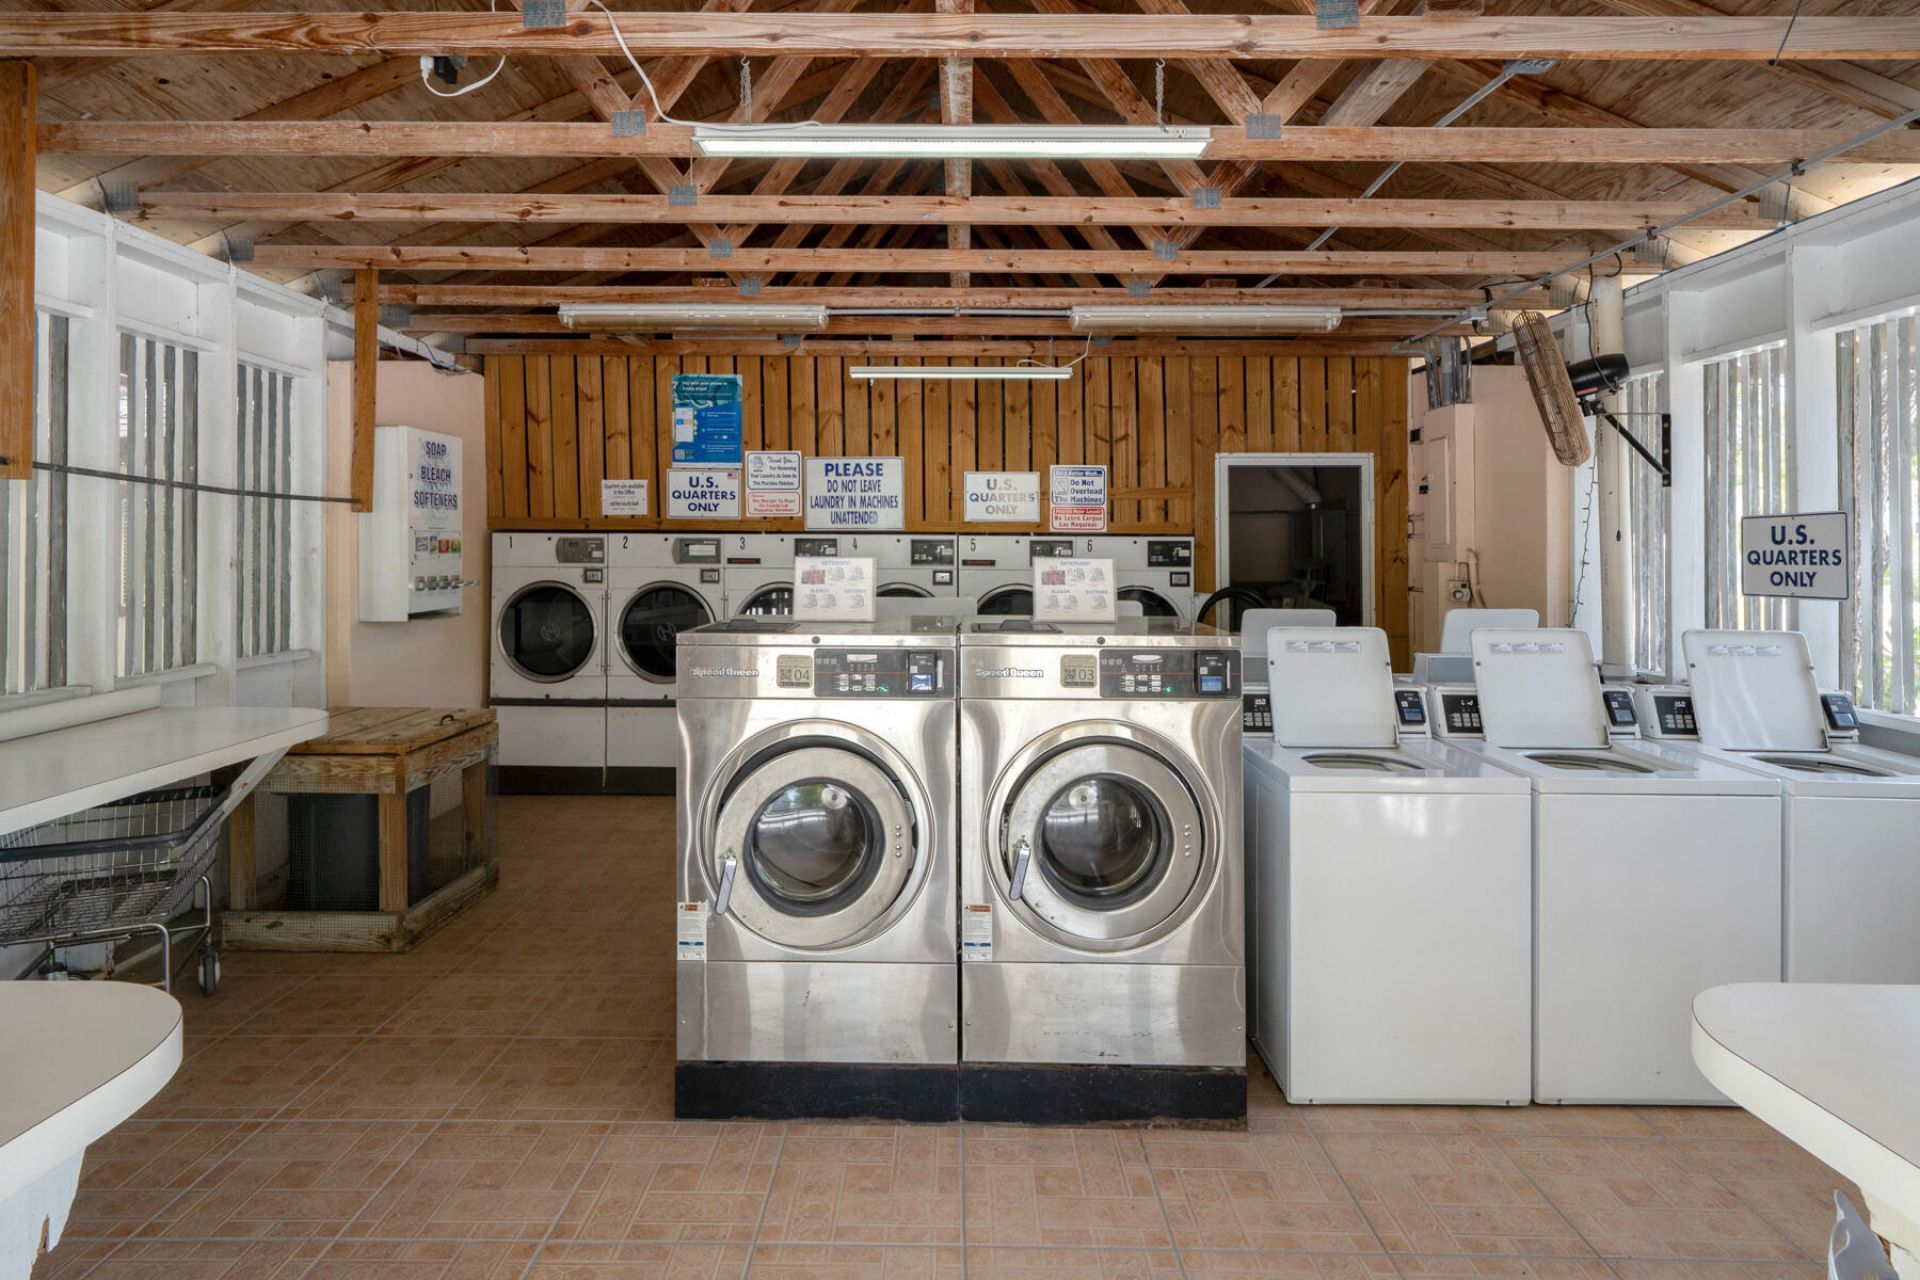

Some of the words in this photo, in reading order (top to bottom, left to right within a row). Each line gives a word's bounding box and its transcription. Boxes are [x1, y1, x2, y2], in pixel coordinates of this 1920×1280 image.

[426, 441, 447, 456] SOAP
[421, 466, 451, 482] BLEACH
[824, 463, 884, 477] PLEASE
[689, 476, 719, 488] U.S.
[827, 479, 838, 493] DO
[841, 479, 857, 493] NOT
[860, 479, 881, 493] LEAVE
[986, 479, 1018, 491] U.S.
[414, 491, 457, 509] SOFTENERS
[672, 490, 736, 500] QUARTERS
[970, 492, 1035, 502] QUARTERS
[688, 502, 719, 512] ONLY
[810, 495, 845, 509] LAUNDRY
[848, 495, 856, 509] IN
[860, 495, 898, 509] MACHINES
[985, 505, 1018, 515] ONLY
[831, 511, 878, 524] UNATTENDED
[1771, 524, 1815, 545] U.S.
[509, 536, 513, 549] 1
[623, 536, 628, 549] 2
[739, 537, 745, 550] 3
[852, 537, 858, 550] 4
[970, 539, 976, 551] 5
[1087, 540, 1093, 552] 6
[1747, 549, 1842, 566] QUARTERS
[1770, 571, 1817, 587] ONLY
[725, 668, 760, 677] Queen
[794, 669, 809, 681] 04
[976, 667, 1009, 678] Speed
[1010, 667, 1044, 678] Queen
[1078, 669, 1094, 681] 03
